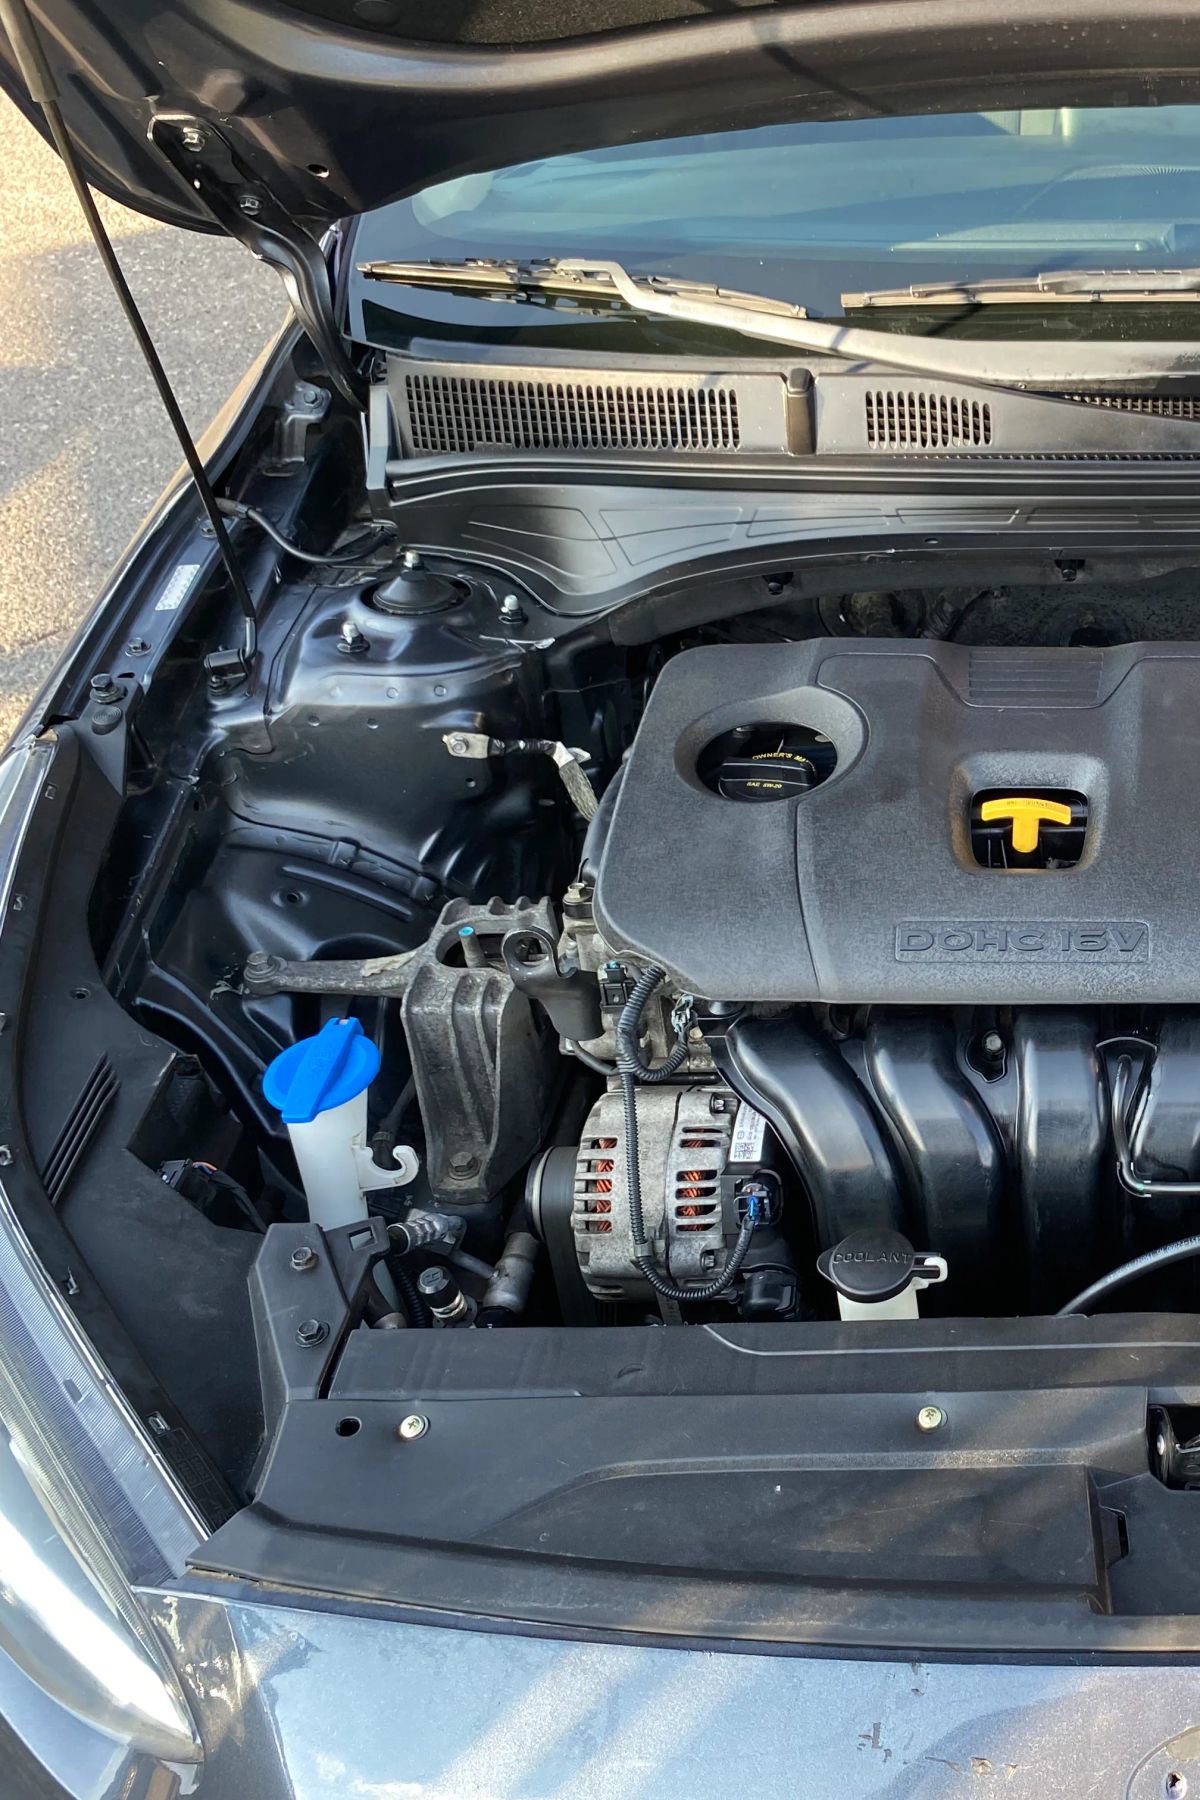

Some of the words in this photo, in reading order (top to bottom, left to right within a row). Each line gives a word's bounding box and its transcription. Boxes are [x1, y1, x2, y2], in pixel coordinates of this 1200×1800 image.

[752, 752, 793, 760] OWNER'S
[900, 930, 1044, 951] DOHC
[1060, 930, 1145, 952] 16V
[832, 1251, 912, 1265] COOLANT
